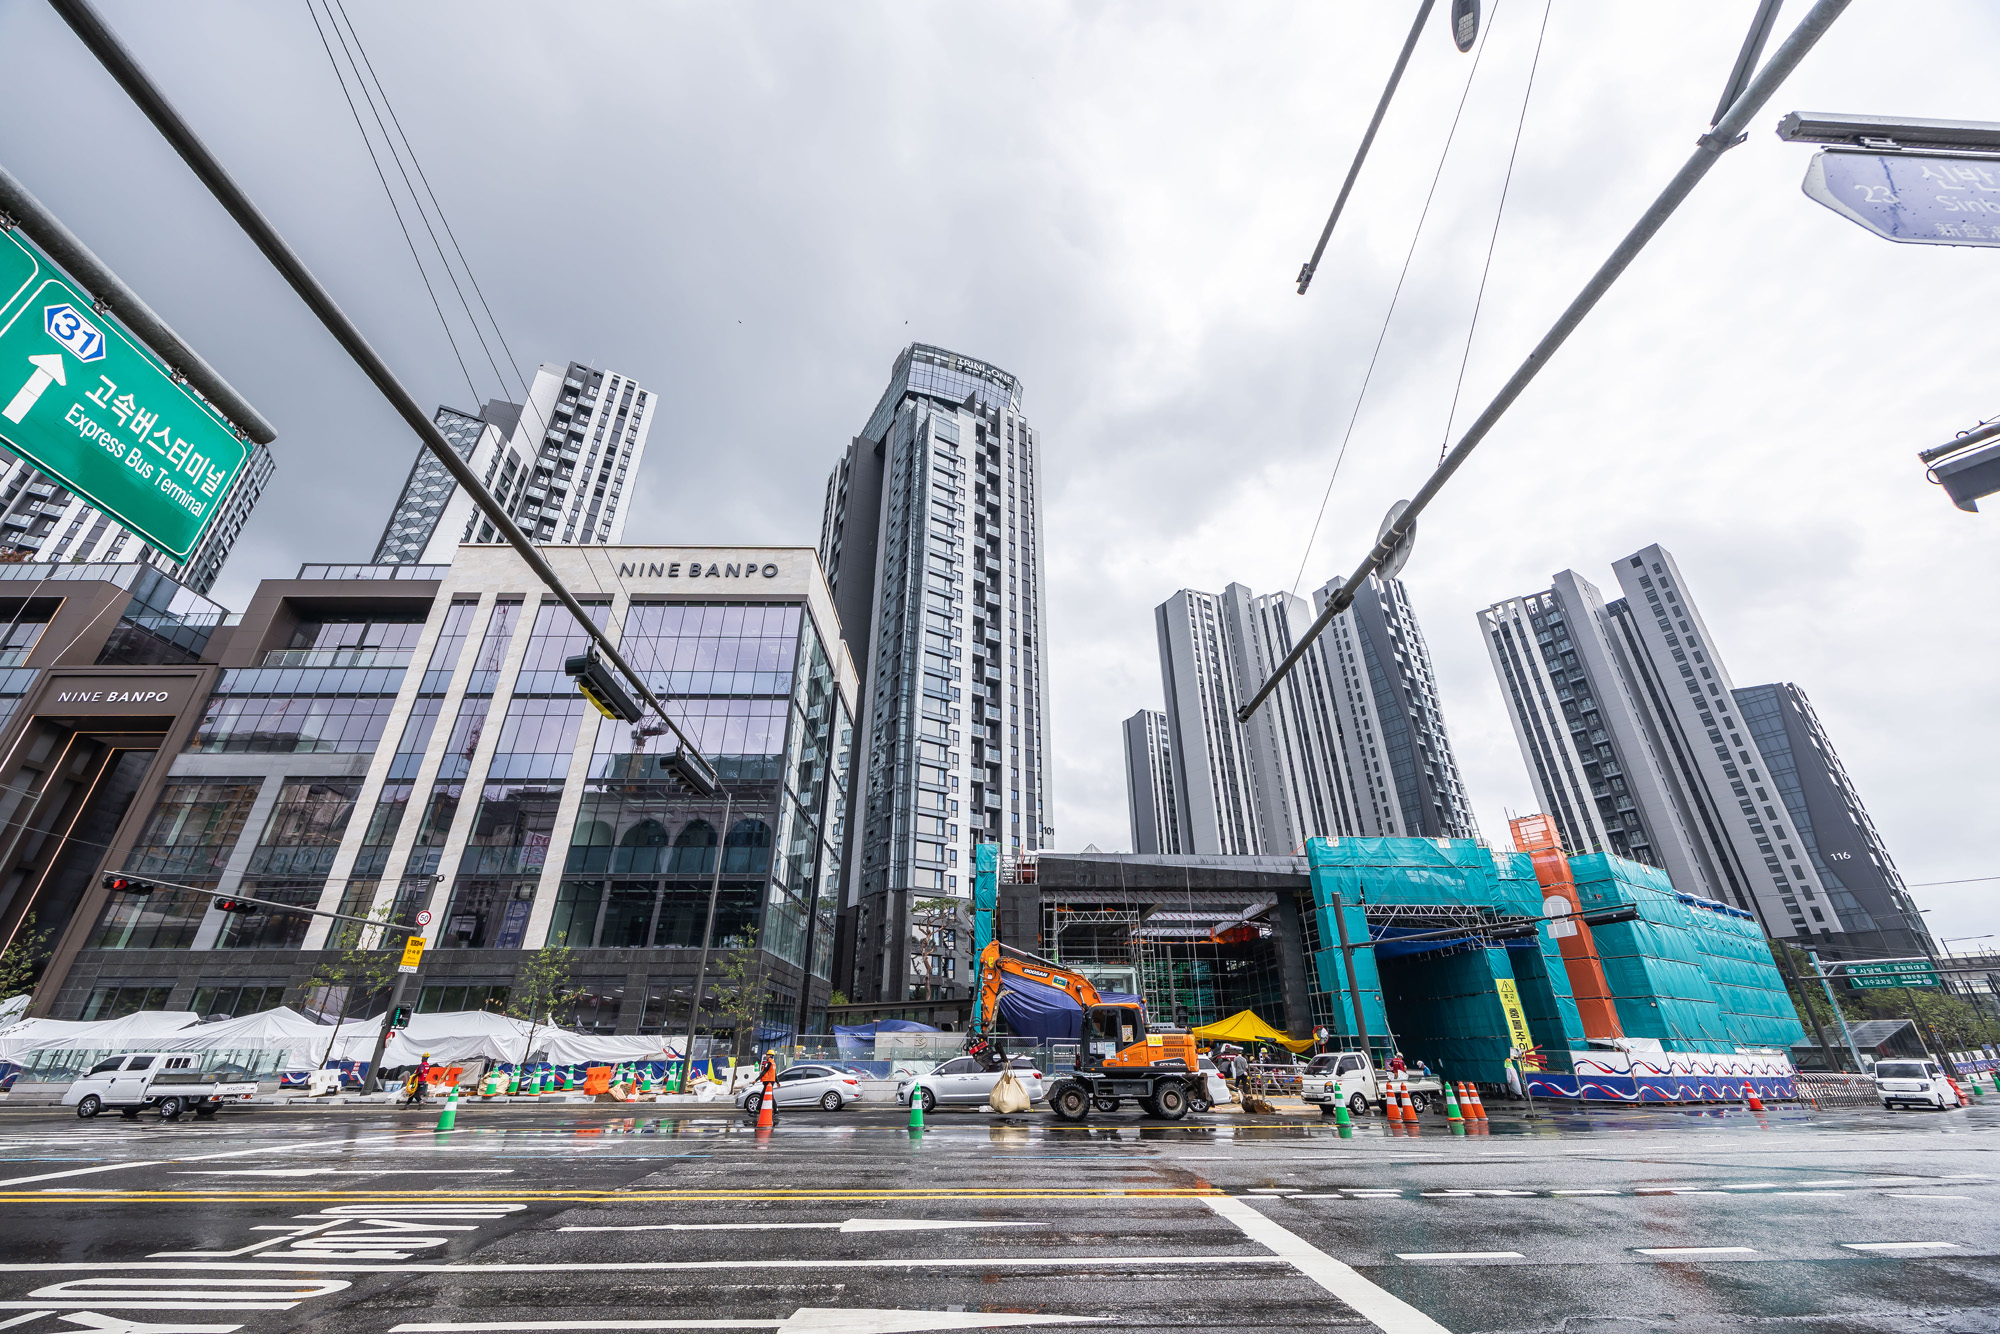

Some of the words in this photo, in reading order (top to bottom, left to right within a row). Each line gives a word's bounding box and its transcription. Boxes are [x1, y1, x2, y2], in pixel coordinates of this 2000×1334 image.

[1920, 165, 2000, 192] 신반
[1854, 184, 1899, 204] 23
[1936, 195, 2000, 214] Sinb
[54, 312, 97, 355] 31
[84, 374, 226, 498] 고속버스터미널
[64, 403, 127, 459] Express
[124, 446, 155, 479] Bus
[154, 469, 208, 517] Terminal
[619, 562, 681, 578] NINE
[688, 562, 779, 578] BANPO
[57, 691, 102, 702] NINE
[106, 691, 169, 702] BANPO
[1043, 826, 1055, 836] 101
[1830, 851, 1852, 861] 116
[419, 914, 429, 922] 50
[1023, 968, 1048, 978] DOOSAN
[145, 1203, 528, 1259] 이수역
